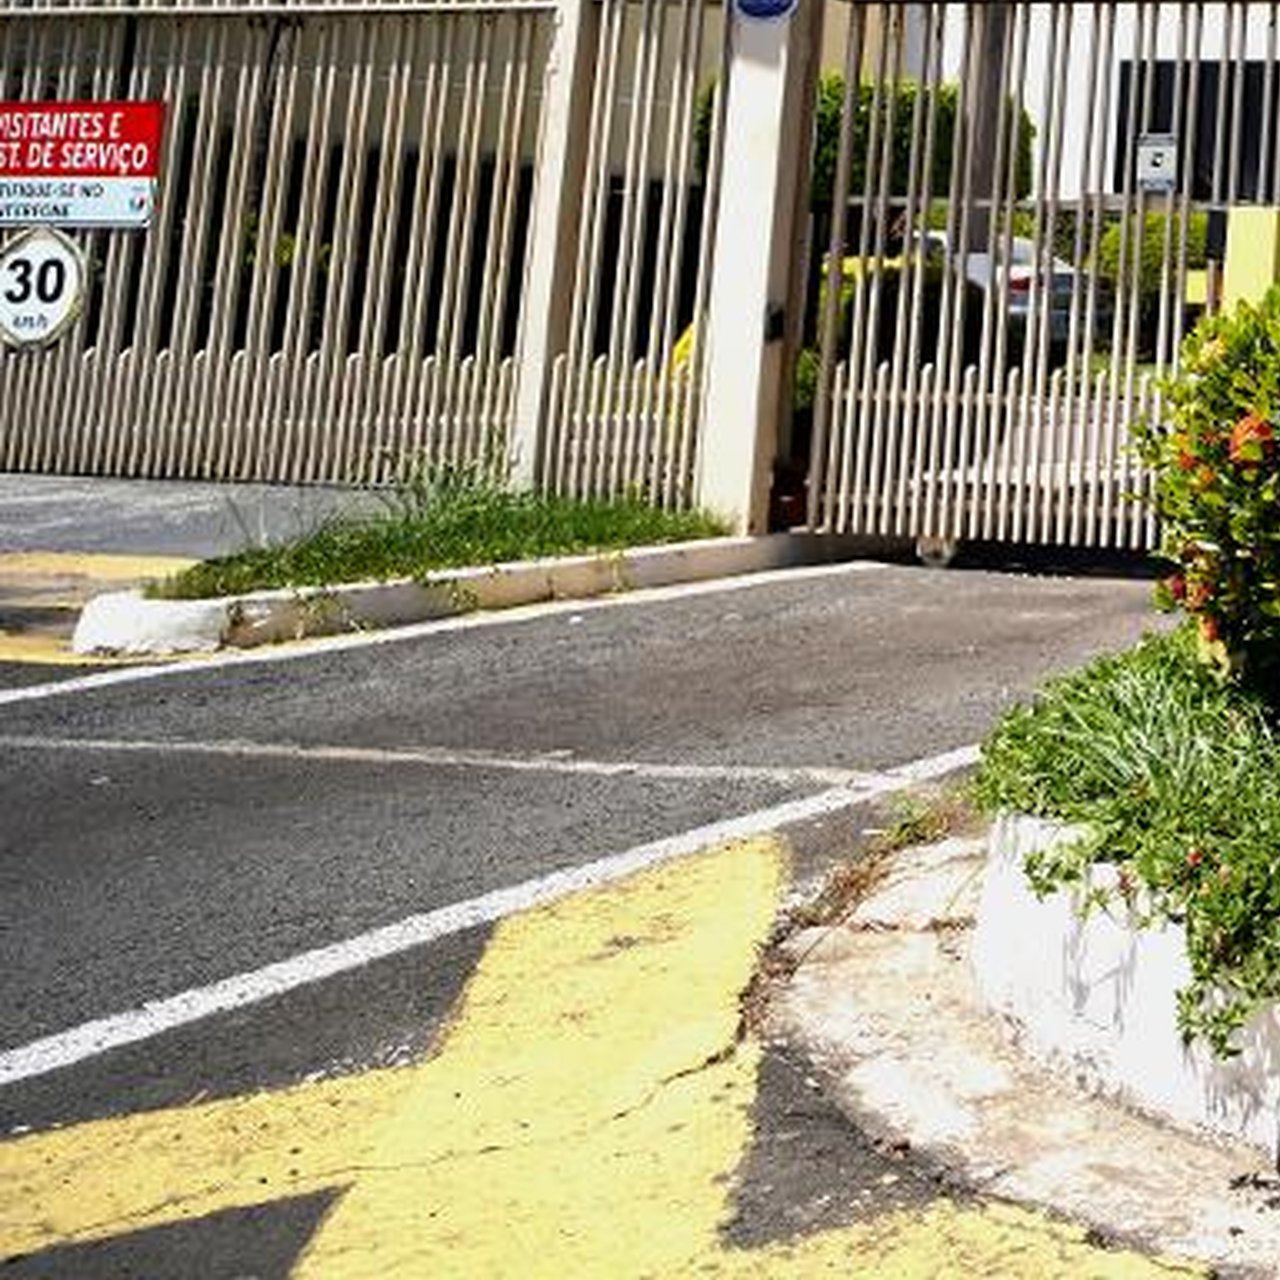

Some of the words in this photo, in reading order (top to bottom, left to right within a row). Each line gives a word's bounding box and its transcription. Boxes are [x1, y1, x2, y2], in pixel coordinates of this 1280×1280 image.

[0, 111, 106, 138] ISITANTES
[109, 111, 124, 138] E
[26, 141, 54, 169] DE
[60, 142, 148, 175] SERVIÇO
[5, 259, 66, 303] 30
